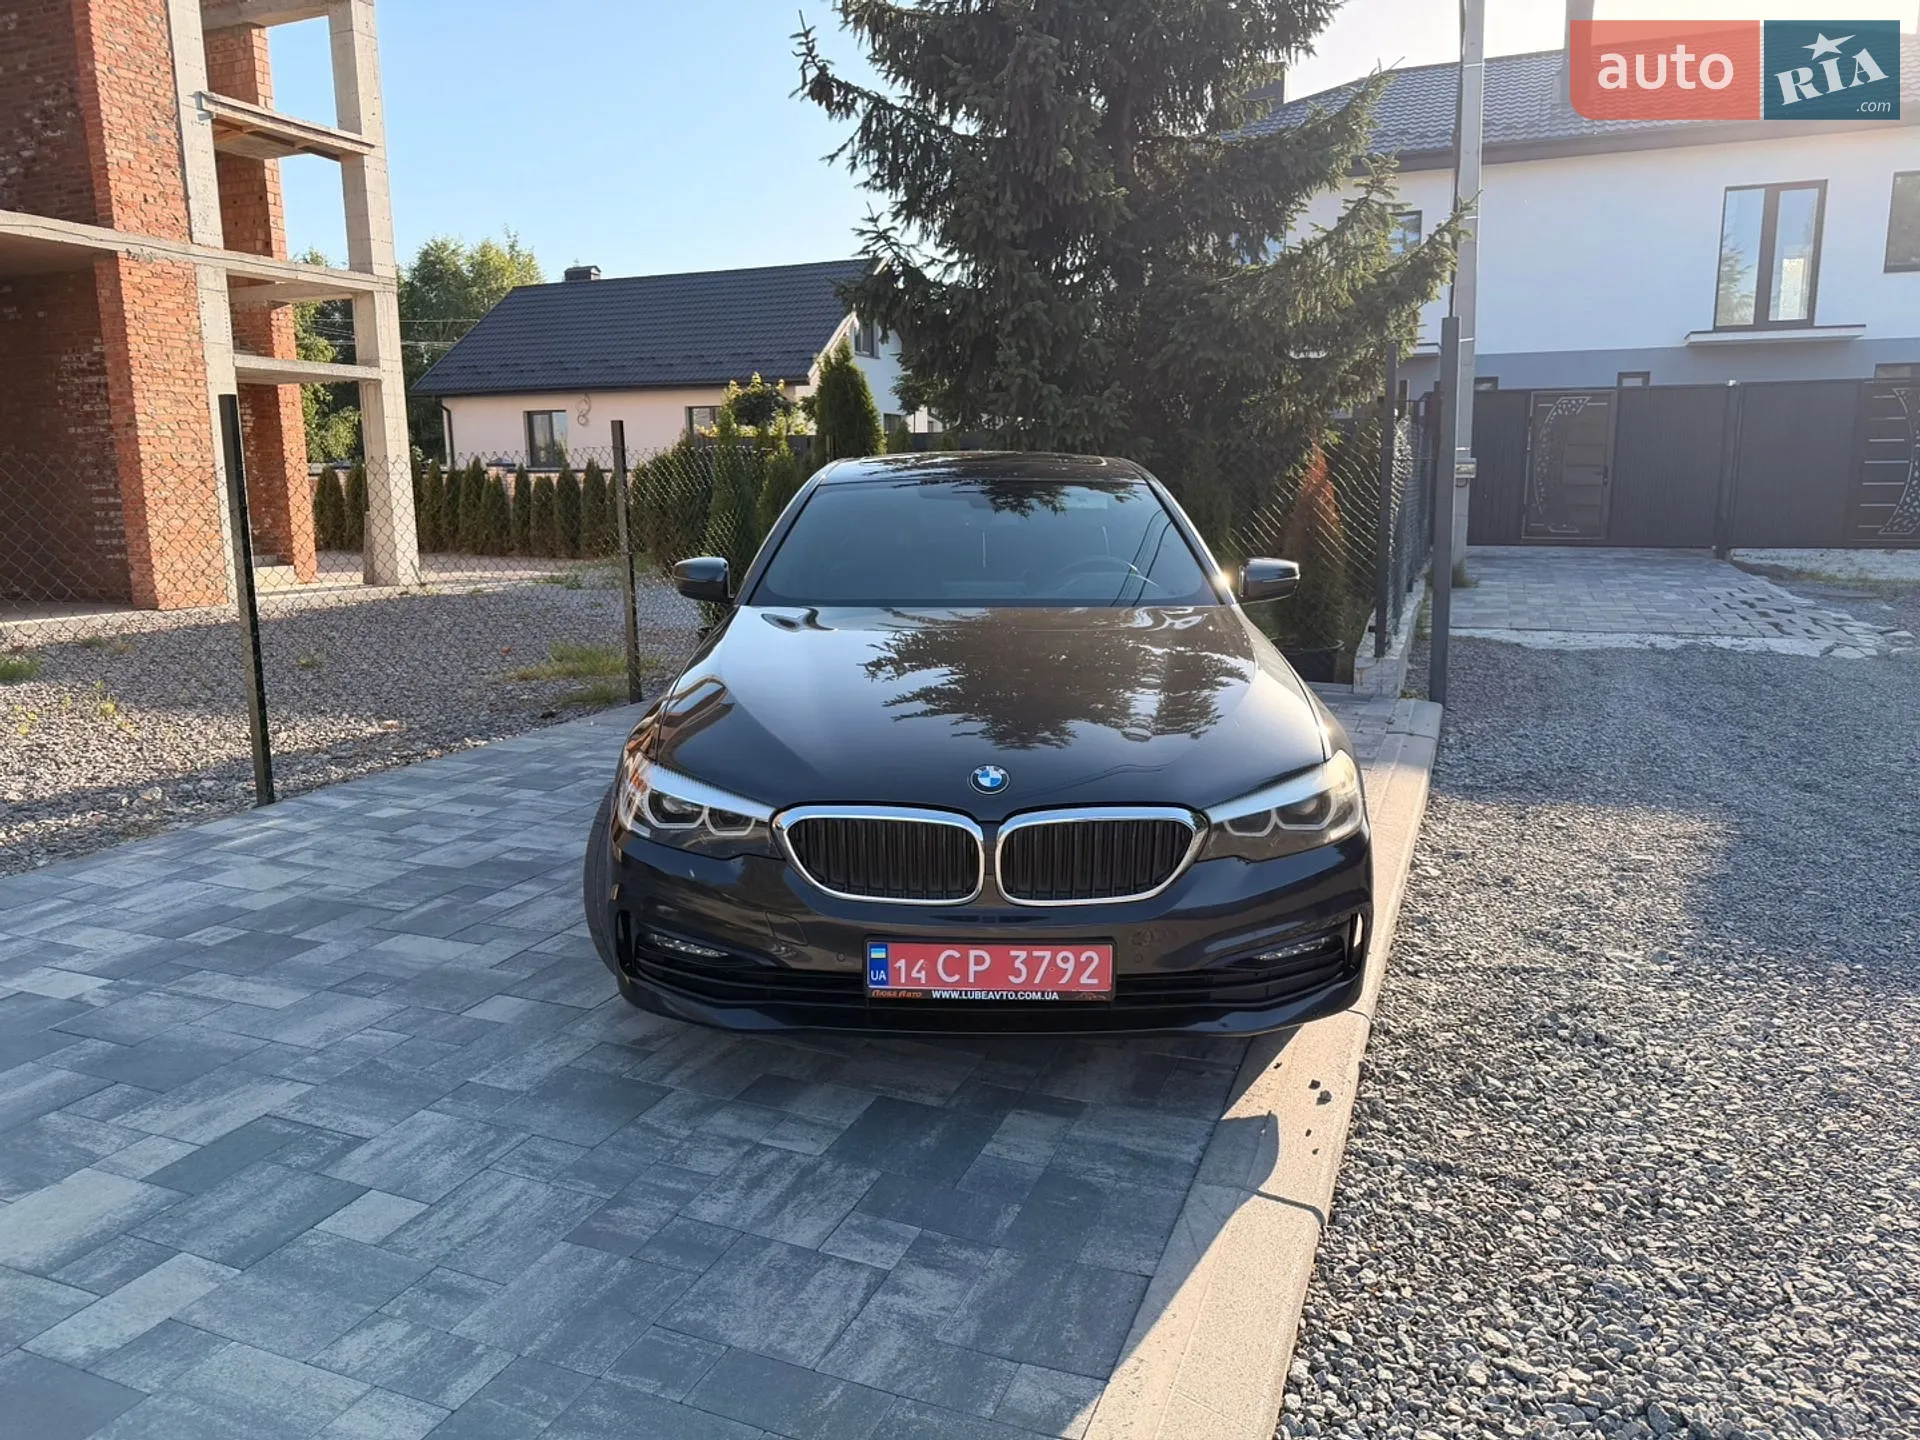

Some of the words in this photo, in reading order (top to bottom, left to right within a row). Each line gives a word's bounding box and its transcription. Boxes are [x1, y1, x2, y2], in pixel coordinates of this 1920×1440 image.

[893, 958, 927, 984] 14
[936, 949, 992, 983] CP
[1008, 950, 1100, 984] 3792
[870, 969, 887, 981] UA
[931, 990, 1060, 1001] WWW.LUBEAVTO.COM.UA
